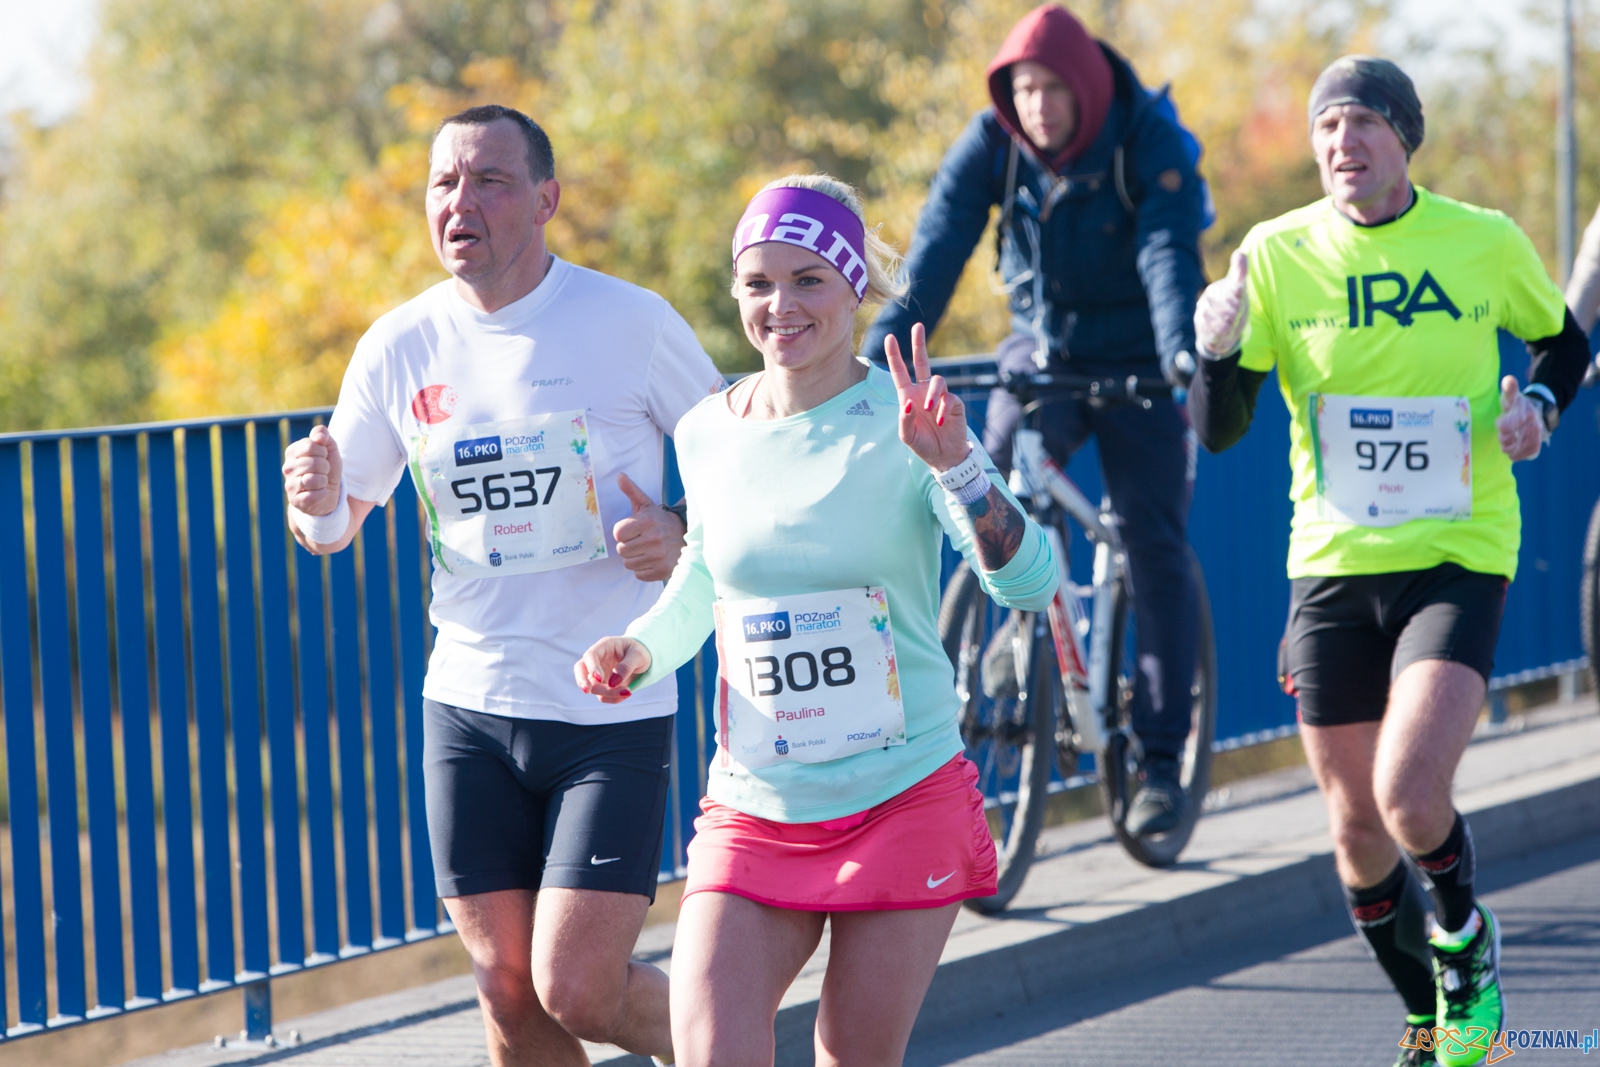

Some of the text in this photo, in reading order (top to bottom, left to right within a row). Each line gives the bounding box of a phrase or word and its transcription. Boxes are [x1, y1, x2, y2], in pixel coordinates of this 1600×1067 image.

[531, 378, 565, 387] CRAFT
[506, 442, 545, 454] maraton
[1355, 440, 1429, 472] 976
[450, 466, 562, 514] 5637
[494, 521, 533, 536] Robert
[795, 619, 841, 632] maraton
[744, 646, 856, 697] 1308
[775, 707, 825, 723] Paulina
[791, 738, 826, 749] Bank Polski
